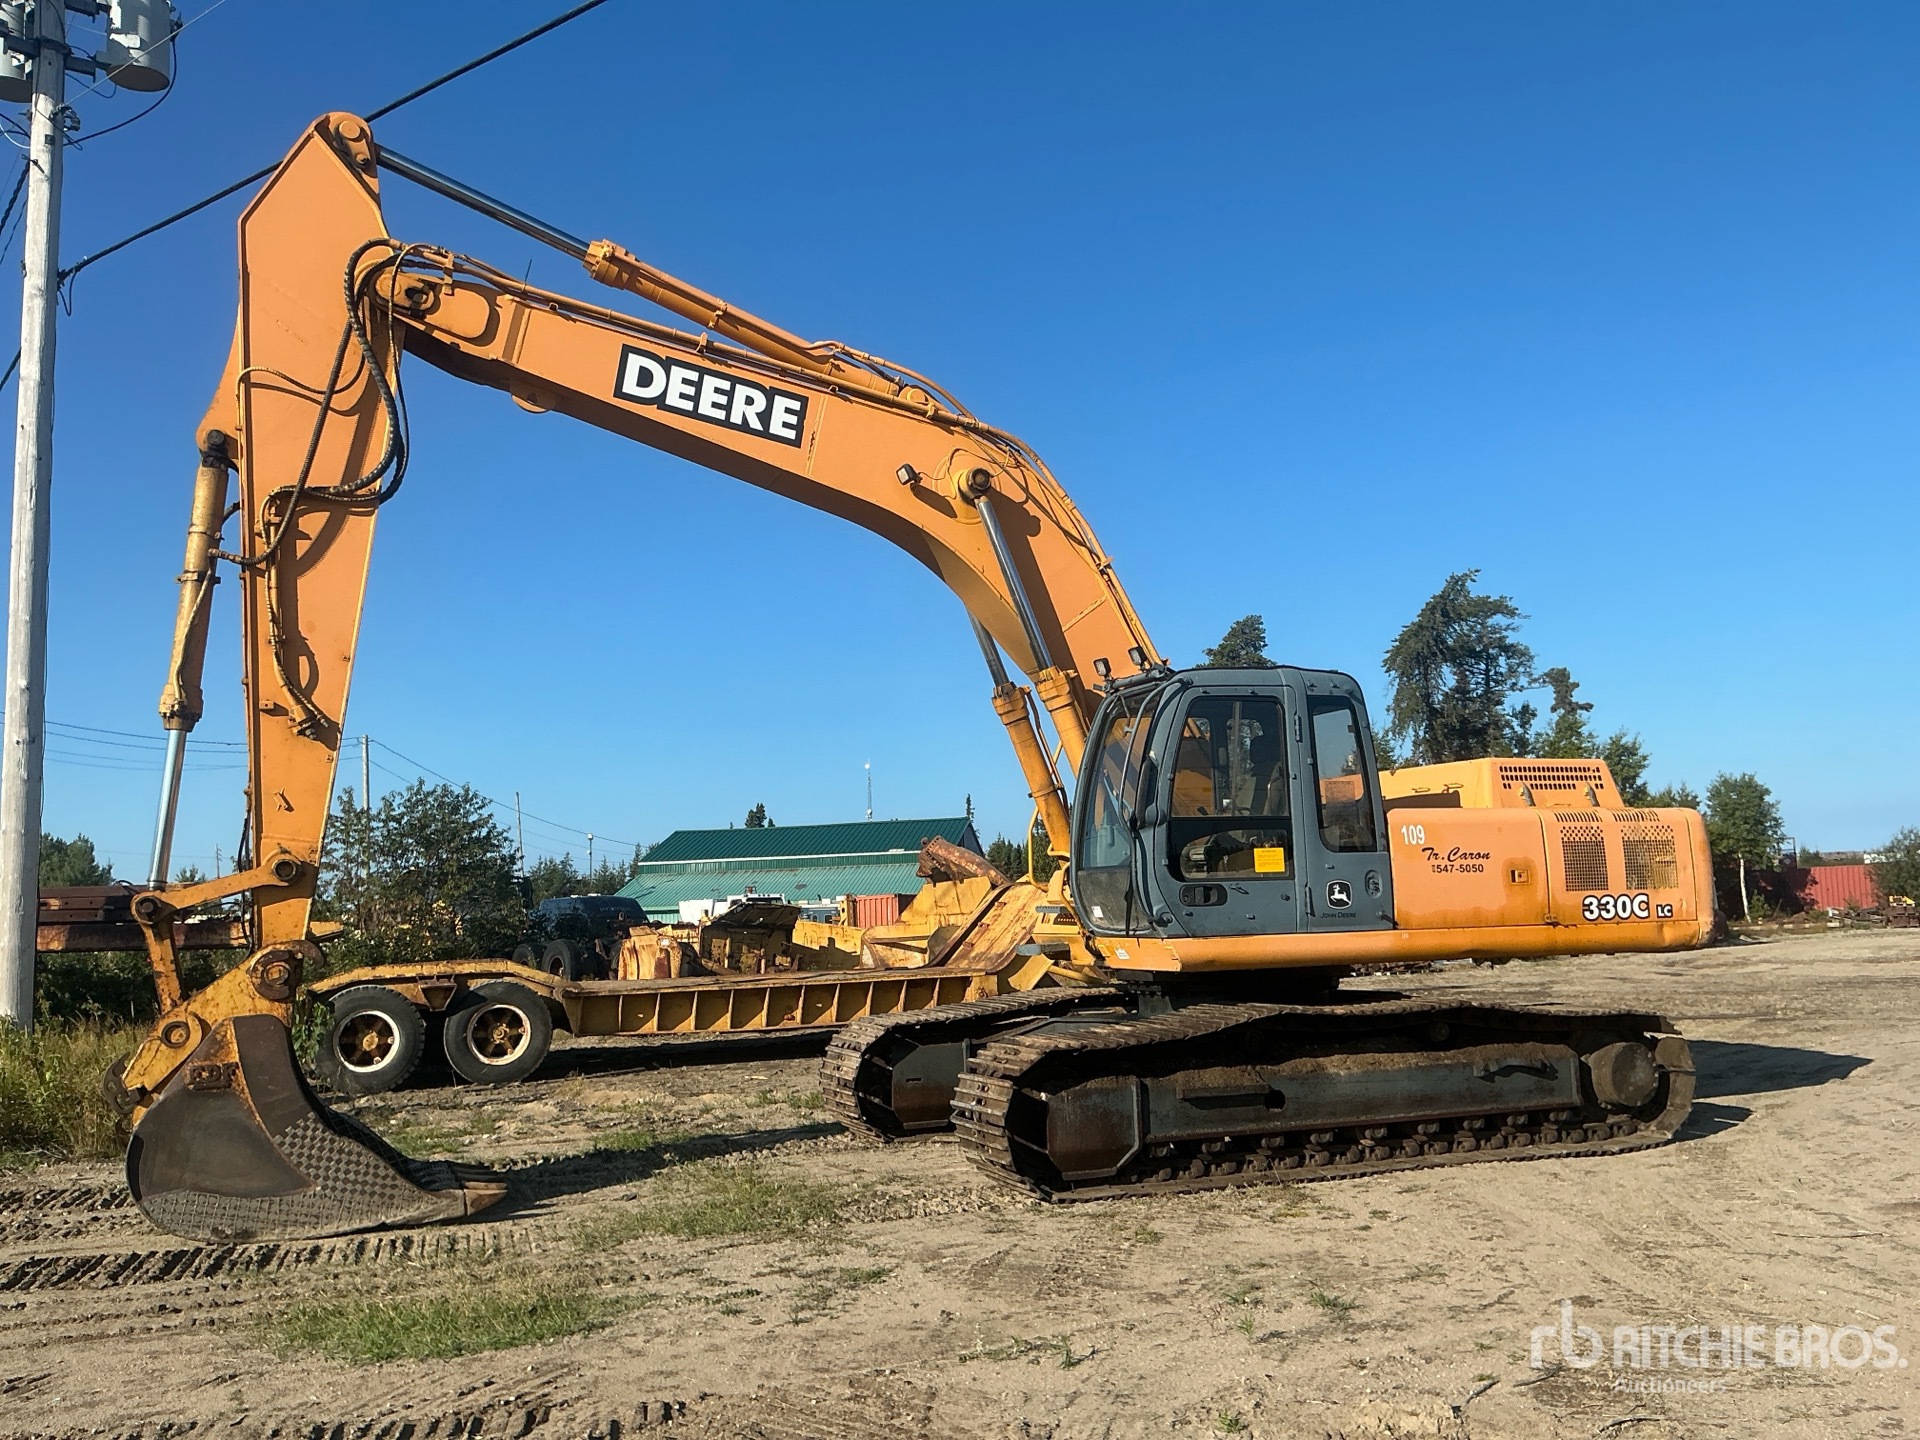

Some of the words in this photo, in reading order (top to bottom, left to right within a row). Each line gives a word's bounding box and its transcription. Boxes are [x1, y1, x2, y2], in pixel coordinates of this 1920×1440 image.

[621, 352, 802, 440] DEERE
[1401, 824, 1425, 845] 109
[1583, 894, 1650, 920] 330C
[1656, 904, 1673, 918] LC
